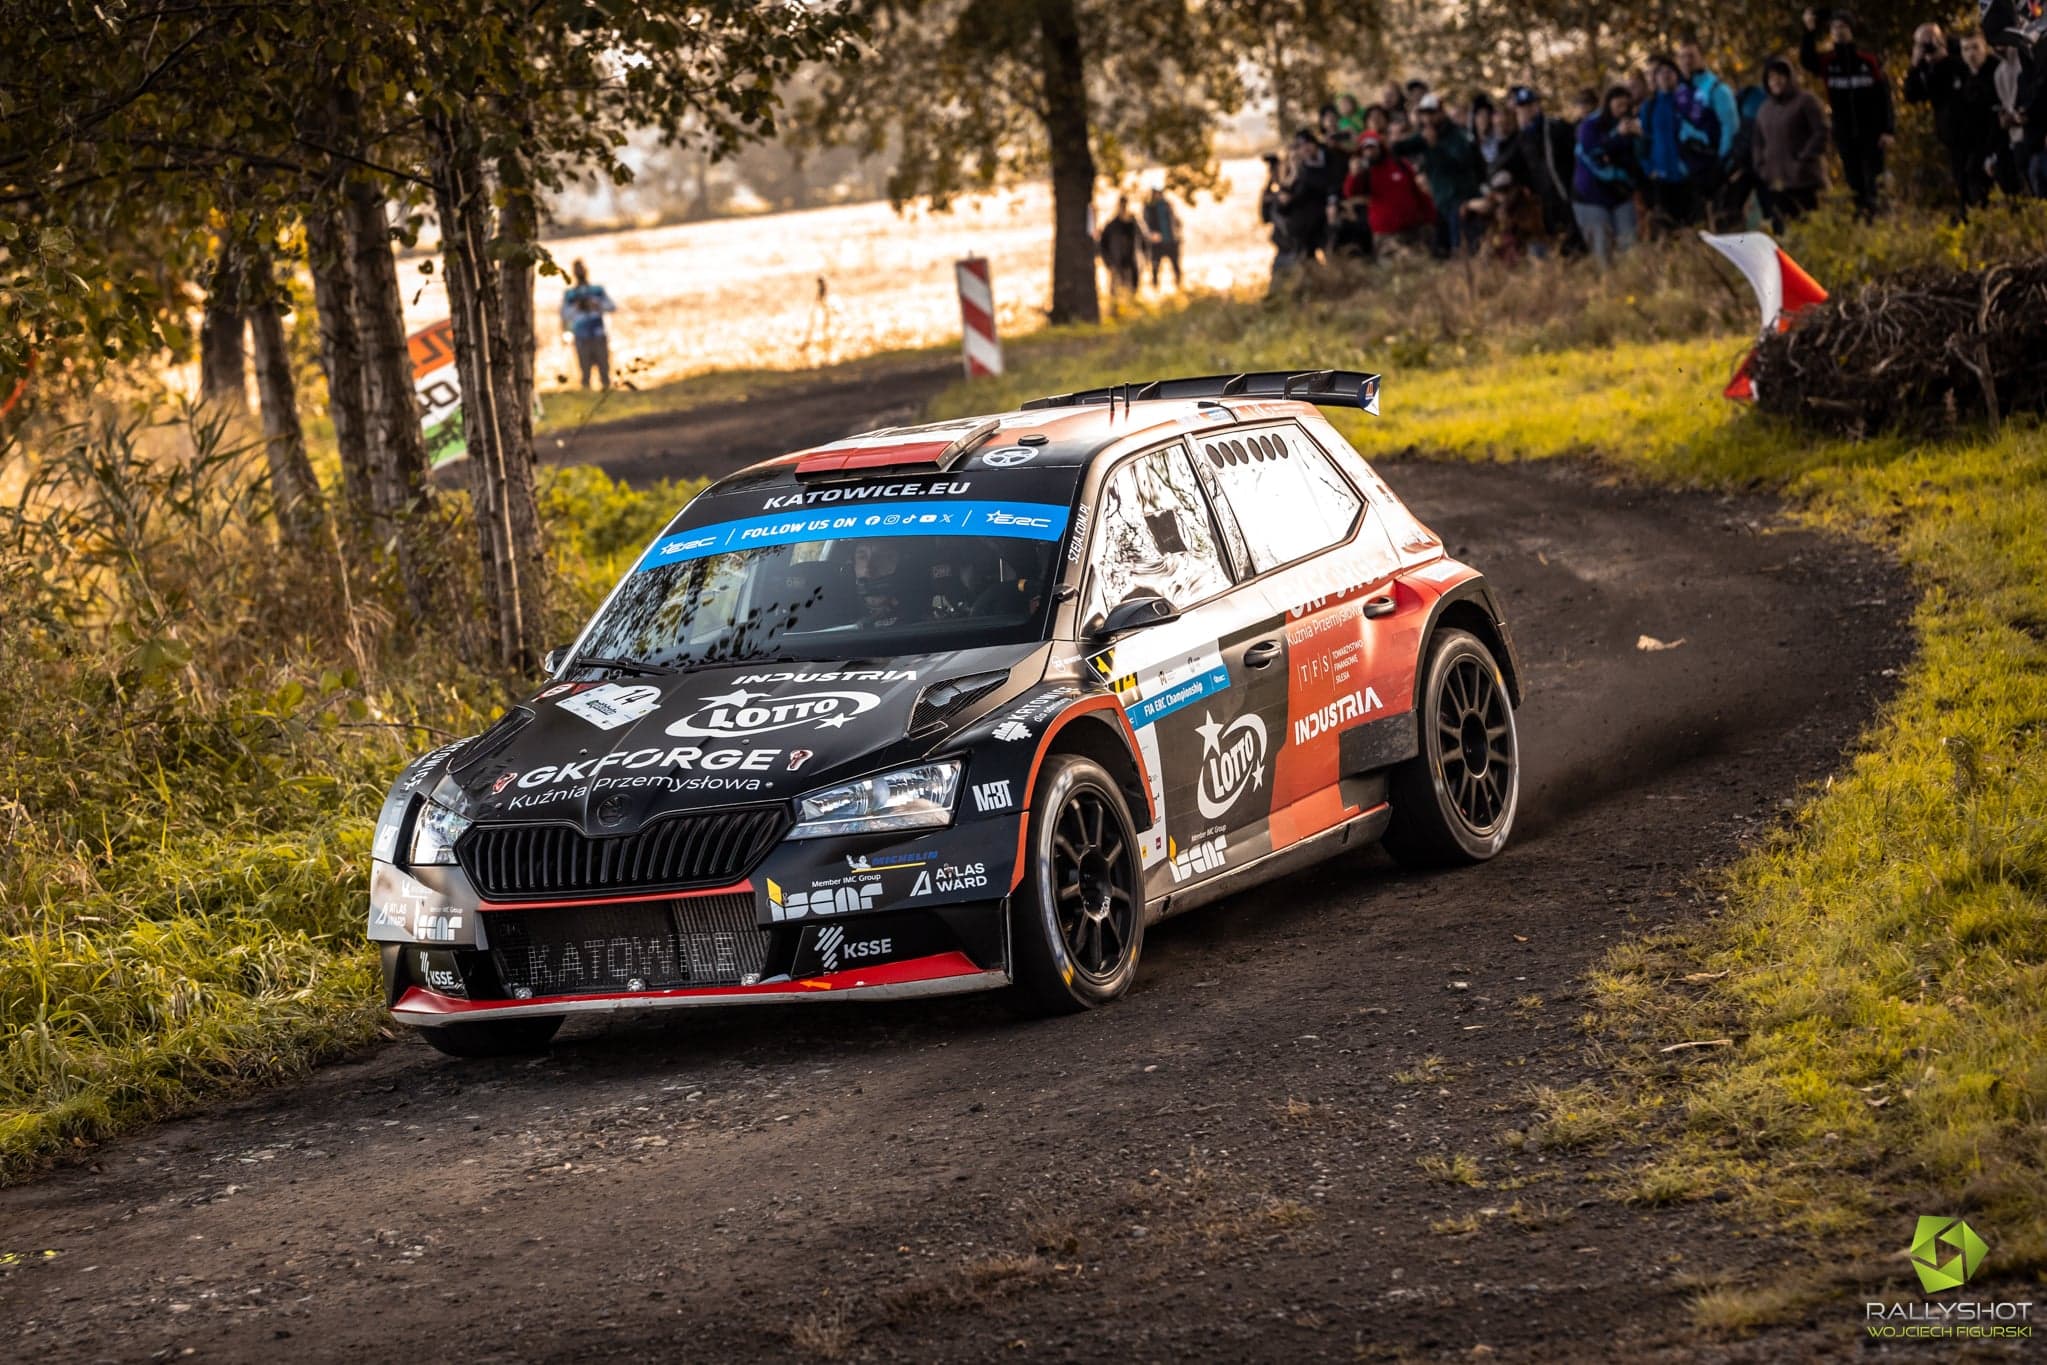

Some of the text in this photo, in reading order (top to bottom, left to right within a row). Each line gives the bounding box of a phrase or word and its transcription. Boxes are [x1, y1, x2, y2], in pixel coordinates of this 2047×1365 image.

[763, 482, 971, 510] KATOWICE.EU
[741, 517, 857, 539] FOLLOW US ON
[1068, 503, 1091, 565] SZEJA.COM.PL
[731, 670, 917, 686] INDUSTRIA
[1143, 704, 1156, 718] FIA
[1166, 680, 1204, 706] Championship
[708, 698, 839, 729] LOTTO
[1294, 686, 1384, 746] INDUSTRIA
[1209, 729, 1254, 799] LOTTO
[508, 773, 761, 811] Kuźnia Przemysłowa
[811, 873, 882, 889] Member IMC Group
[935, 862, 986, 881] ATLAS
[935, 875, 989, 893] WARD
[843, 938, 893, 960] KSSE
